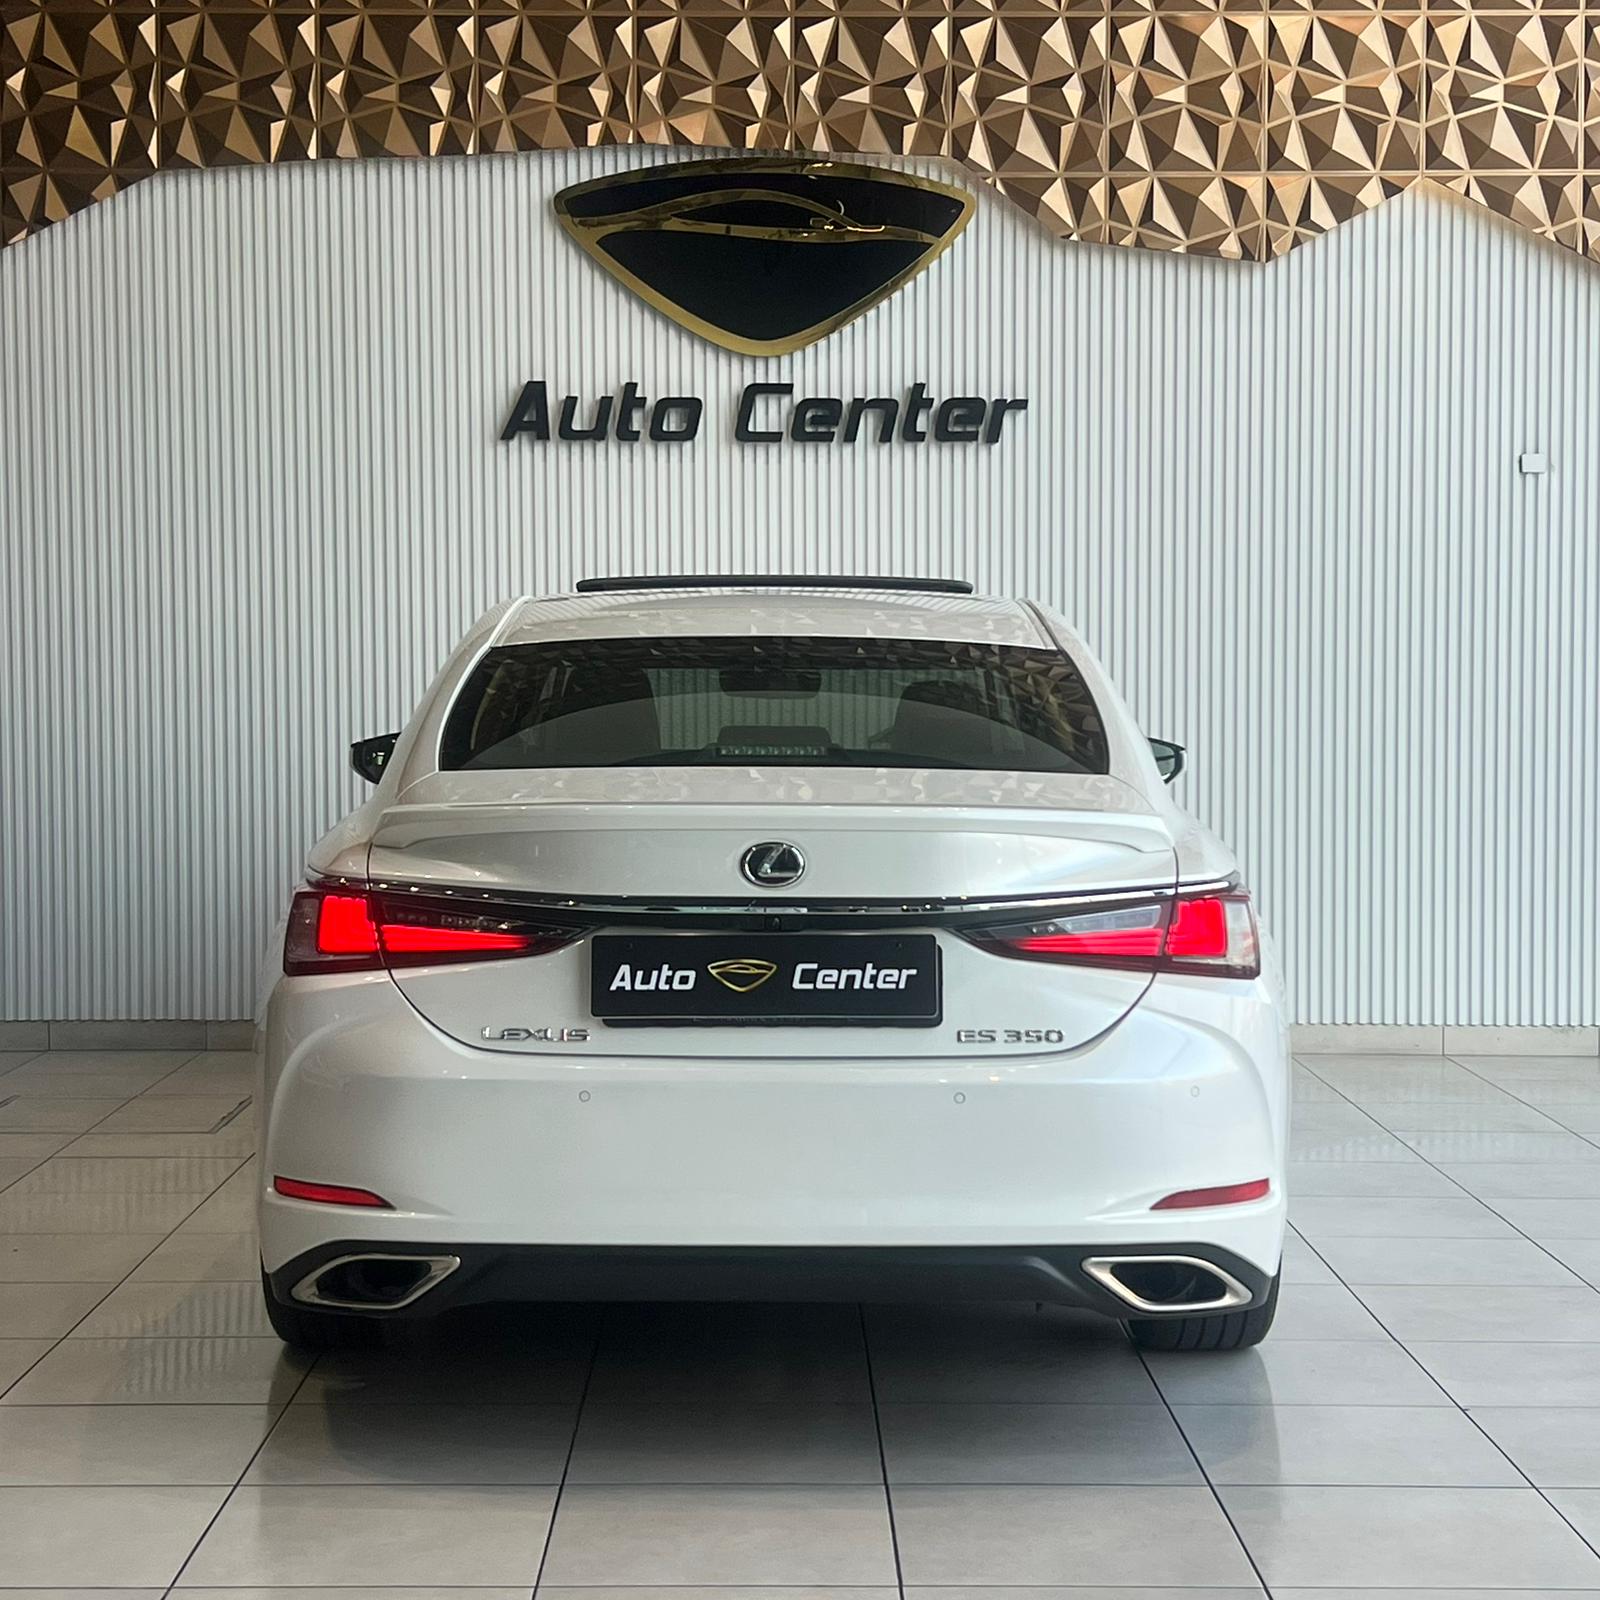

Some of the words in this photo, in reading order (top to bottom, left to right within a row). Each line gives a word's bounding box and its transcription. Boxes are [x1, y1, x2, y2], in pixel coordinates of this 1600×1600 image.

[500, 380, 703, 443] Auto
[735, 382, 1028, 444] Center
[609, 964, 696, 991] Auto
[791, 963, 918, 990] Center
[481, 1026, 591, 1042] LEXUS
[957, 1029, 998, 1043] ES
[1003, 1029, 1064, 1043] 350
